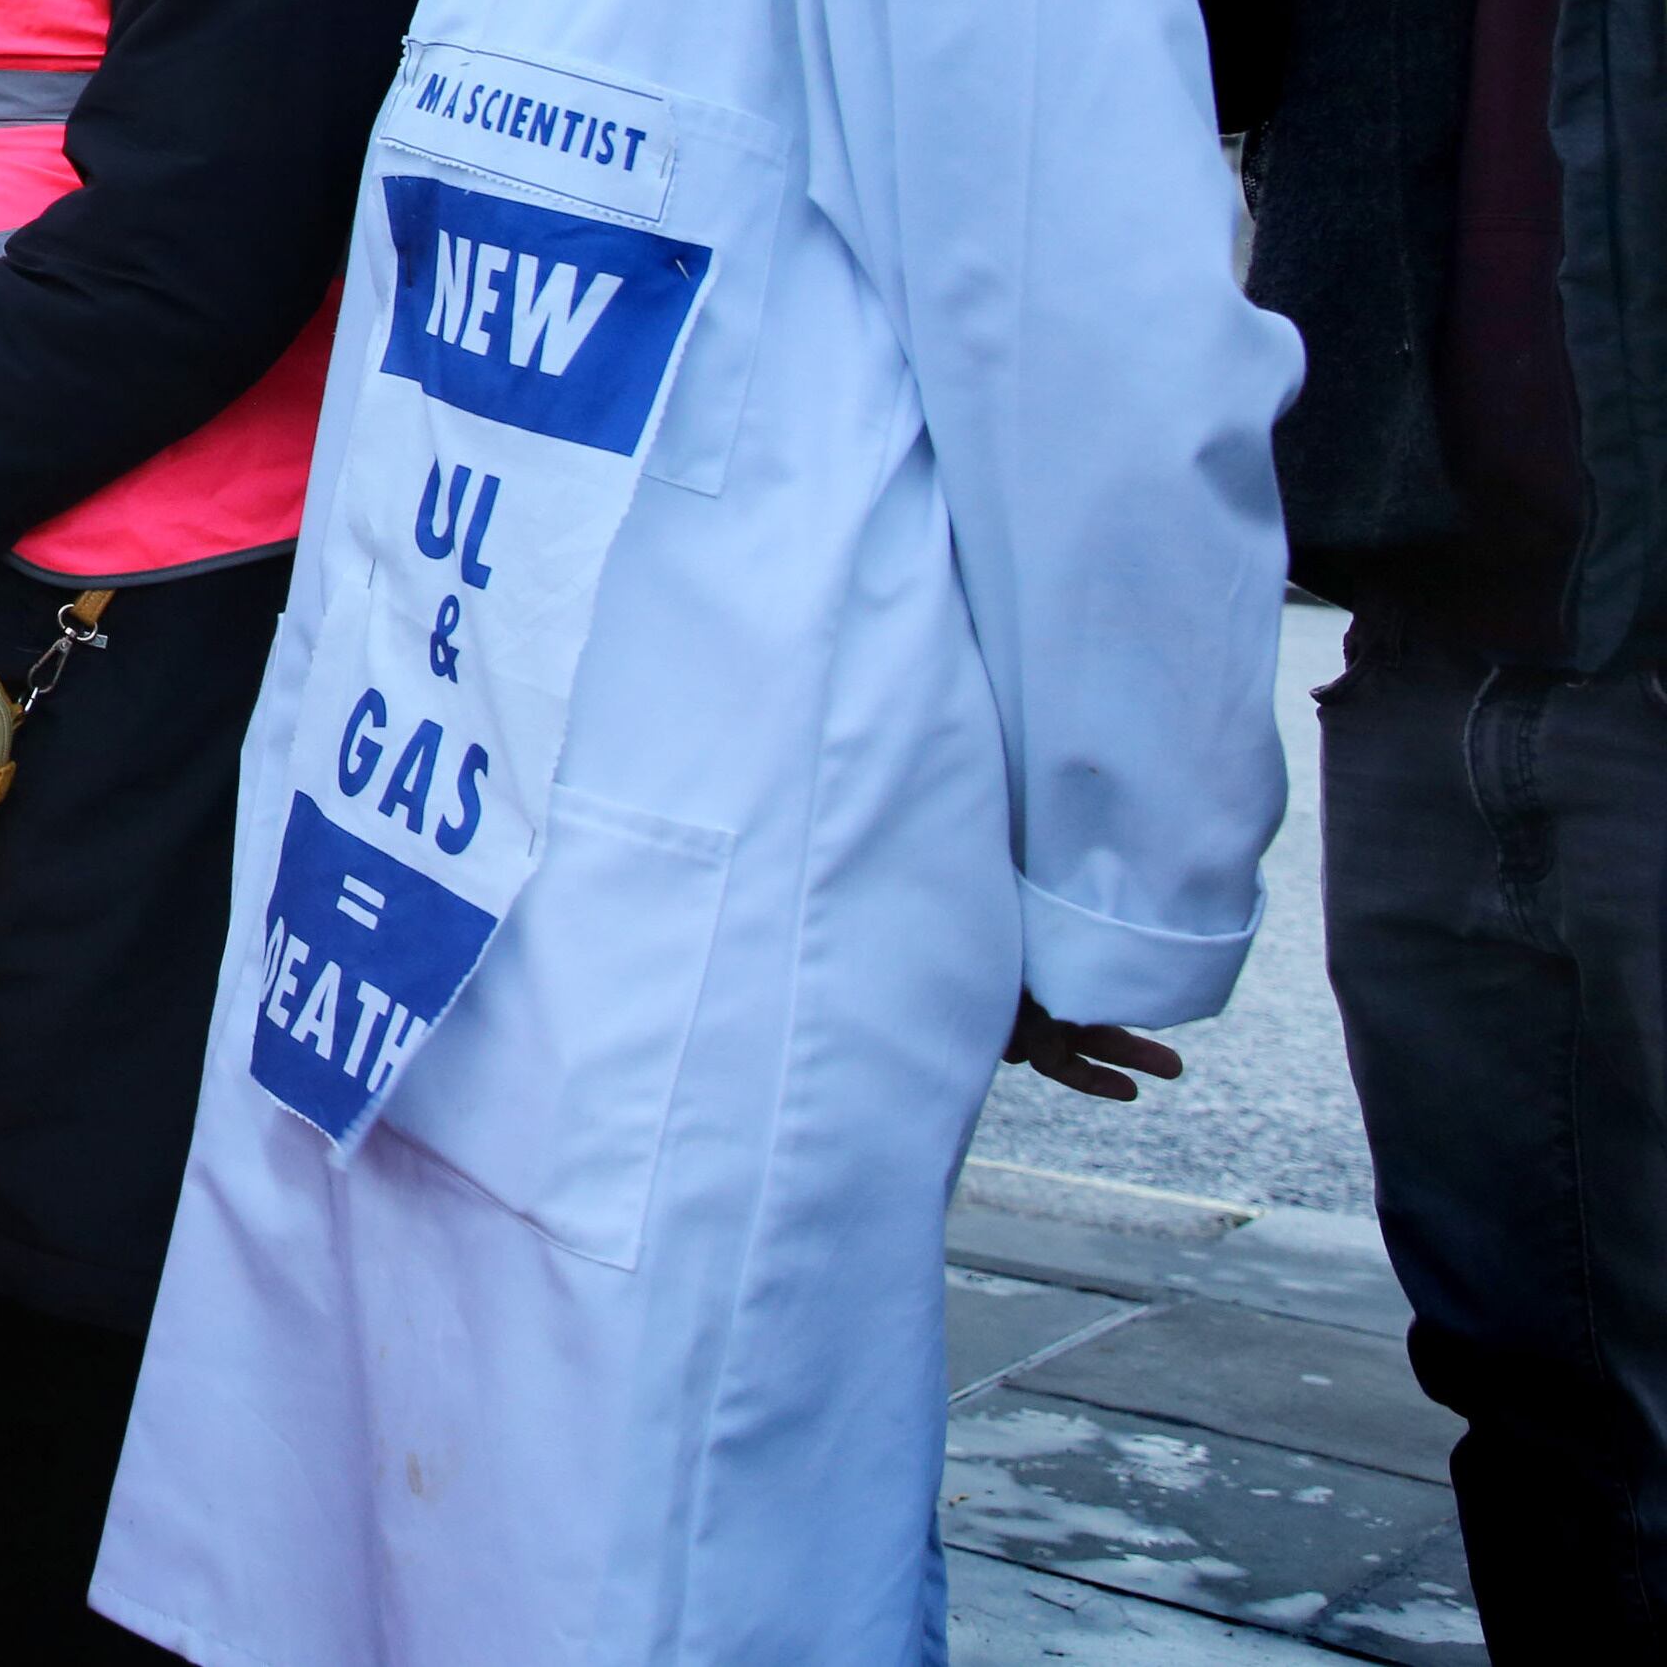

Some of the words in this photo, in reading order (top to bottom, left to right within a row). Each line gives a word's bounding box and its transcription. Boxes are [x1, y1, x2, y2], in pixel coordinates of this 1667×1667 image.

[441, 80, 463, 119] A
[462, 84, 647, 172] SCIENTIST
[425, 228, 624, 377] NEW
[430, 593, 461, 684] &
[337, 686, 489, 856] GAS
[260, 915, 428, 1094] DEATH
